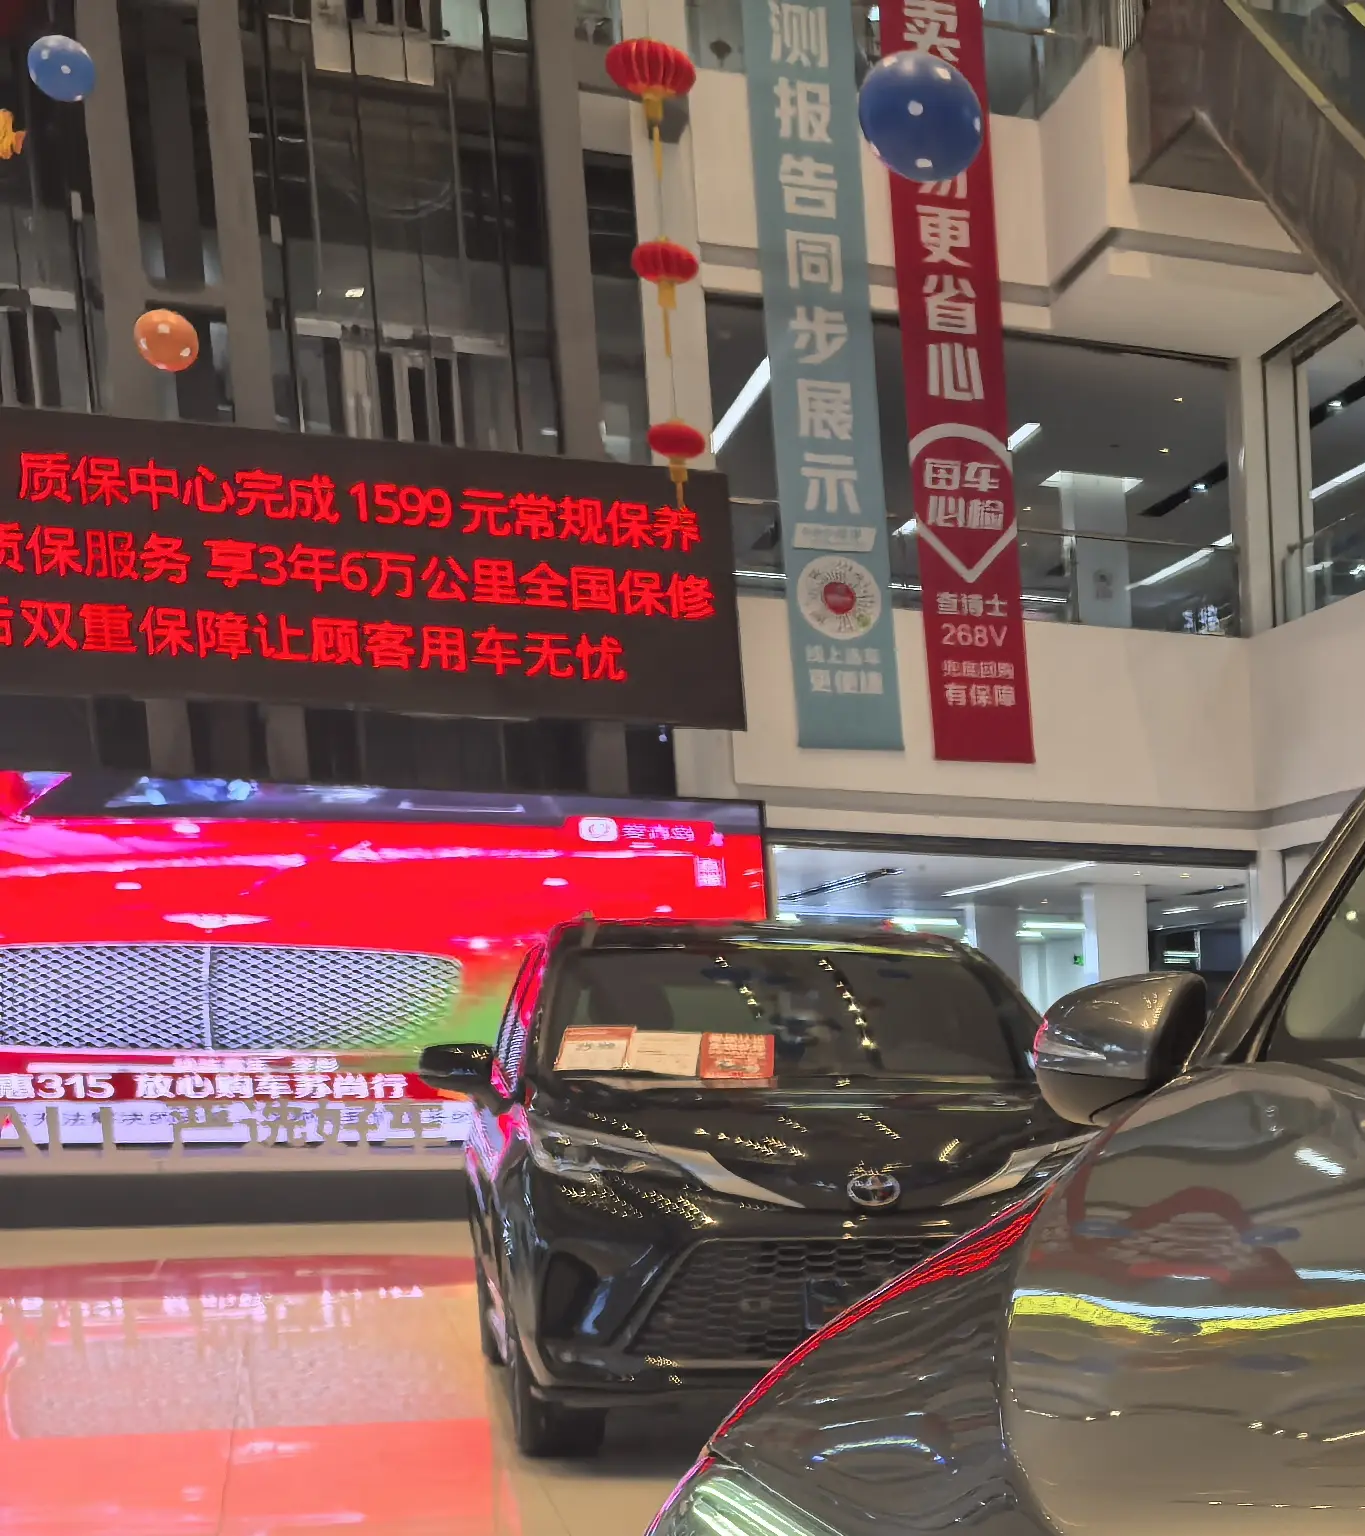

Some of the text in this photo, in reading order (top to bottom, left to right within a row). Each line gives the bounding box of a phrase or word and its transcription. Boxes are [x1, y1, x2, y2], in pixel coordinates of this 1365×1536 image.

[19, 451, 700, 552] 质保中心完成 1599 元常规保养
[204, 537, 715, 621] 享3年6万公里全国保修
[941, 623, 1008, 647] 268V
